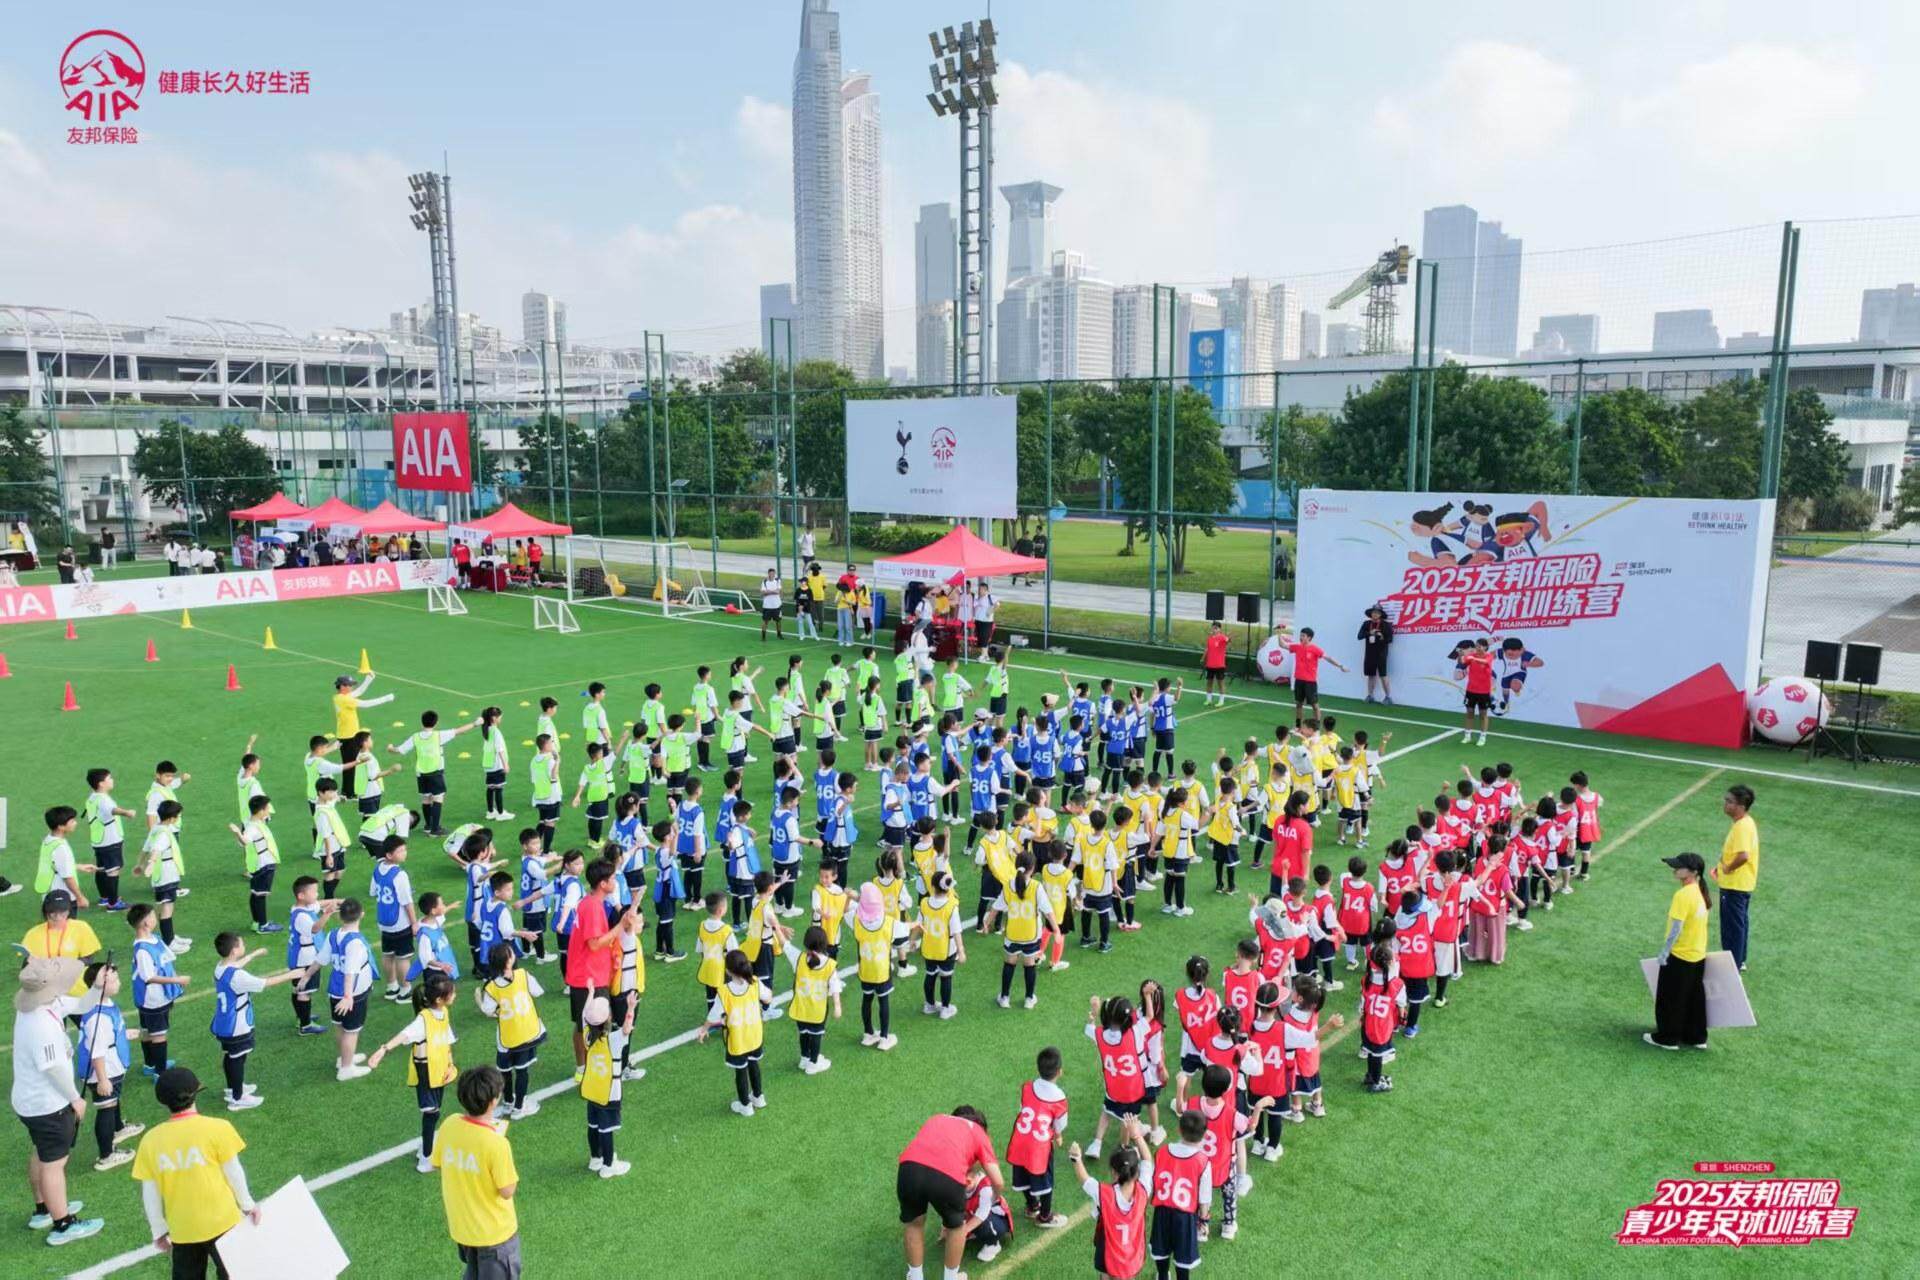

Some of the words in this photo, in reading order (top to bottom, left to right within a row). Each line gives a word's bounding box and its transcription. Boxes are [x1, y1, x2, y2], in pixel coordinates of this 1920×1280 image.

[401, 428, 462, 478] AIA
[1507, 547, 1526, 557] AIA
[345, 567, 393, 590] AIA
[1403, 557, 1596, 595] 2025友邦保险
[217, 576, 269, 600] AIA
[0, 592, 46, 616] IA
[1415, 625, 1439, 633] YOUTH
[1441, 624, 1481, 632] FOOTBALL
[1033, 750, 1052, 764] 45
[972, 777, 989, 794] 36
[1277, 825, 1297, 840] AIA
[1343, 893, 1365, 912] 14
[480, 921, 494, 942] 5
[1400, 934, 1428, 954] 26
[1268, 948, 1285, 968] 3
[1231, 986, 1249, 1009] 6
[1368, 993, 1391, 1019] 15
[1187, 1003, 1217, 1028] 42
[1104, 1054, 1138, 1077] 43
[1016, 1106, 1052, 1142] 33
[156, 1146, 208, 1173] AIA
[1156, 1170, 1193, 1210] 36
